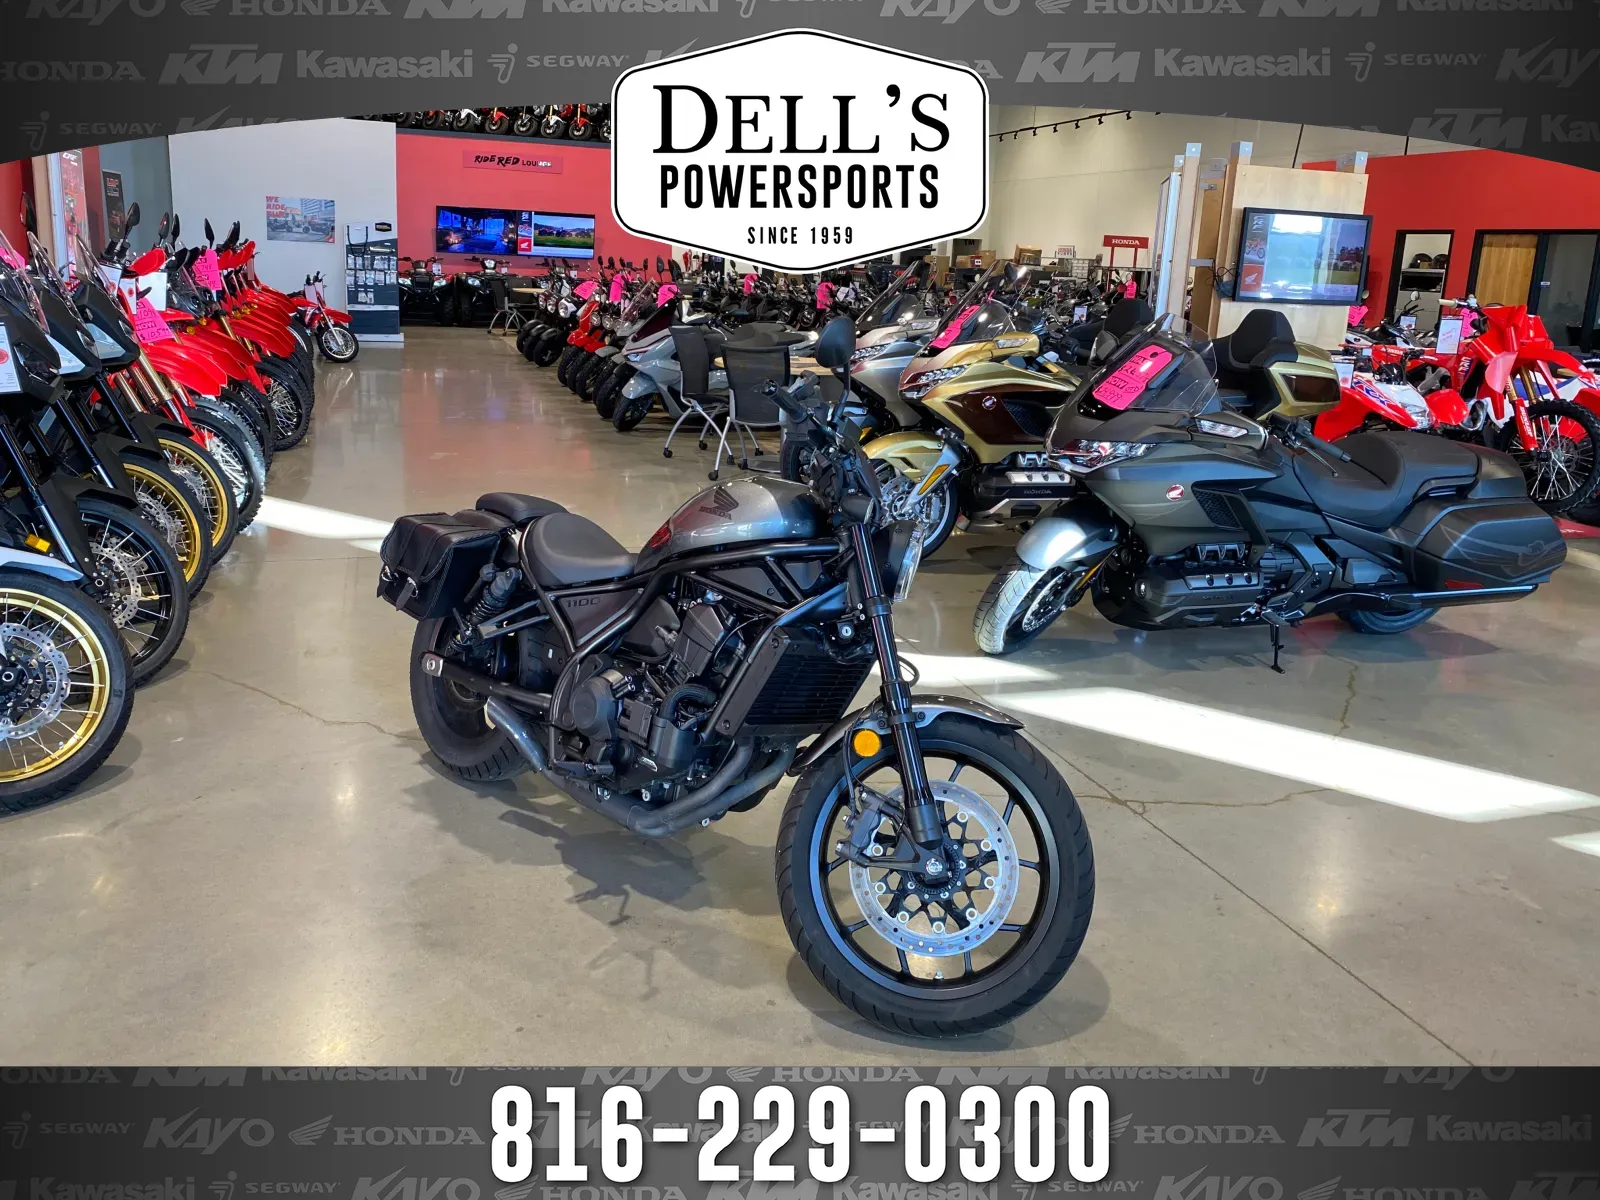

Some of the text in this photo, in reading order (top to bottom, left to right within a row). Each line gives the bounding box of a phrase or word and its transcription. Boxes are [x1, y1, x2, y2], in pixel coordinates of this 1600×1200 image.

[474, 155, 496, 163] RIDE
[497, 156, 520, 167] RED
[1520, 405, 1534, 438] DUNLOP
[698, 506, 732, 520] HONDA
